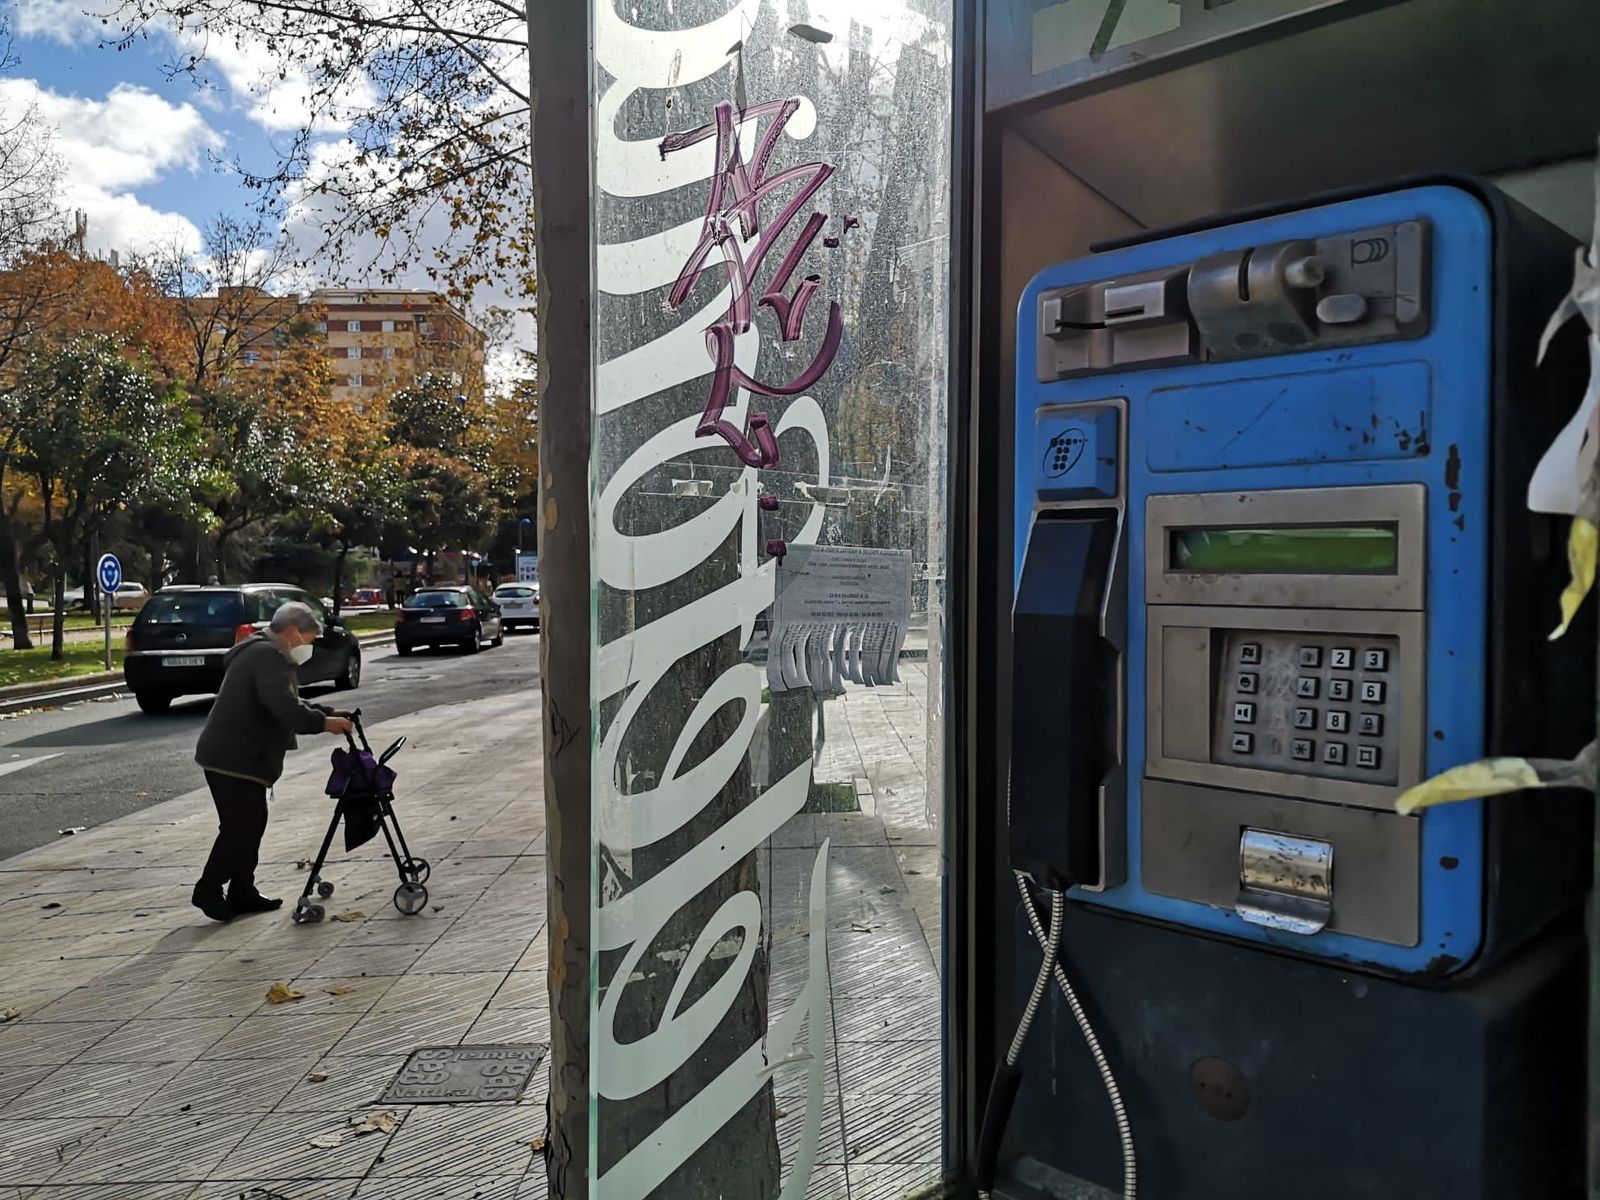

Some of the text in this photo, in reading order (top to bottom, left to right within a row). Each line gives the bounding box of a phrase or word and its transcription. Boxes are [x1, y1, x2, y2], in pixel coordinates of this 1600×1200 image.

[1336, 652, 1345, 664] 2
[1370, 653, 1378, 666] 3
[1302, 681, 1375, 698] 4 5 6
[1299, 712, 1307, 724] 7
[1331, 715, 1340, 727] 8
[1329, 746, 1337, 758] 0
